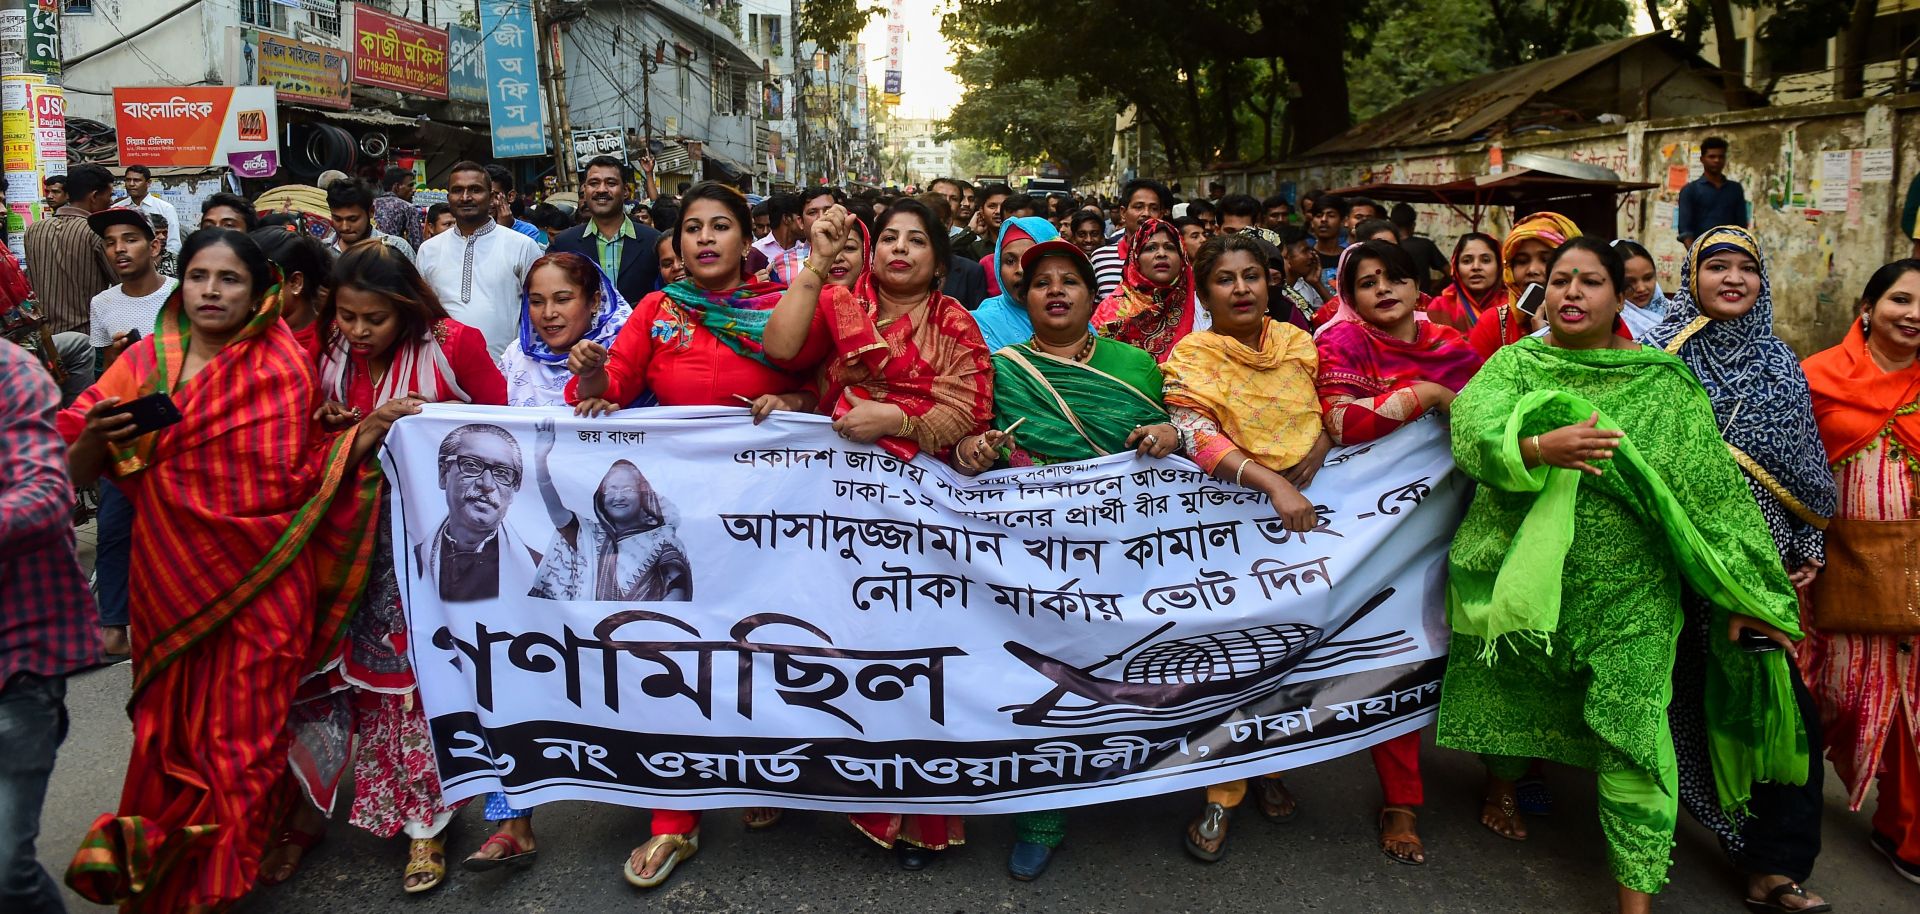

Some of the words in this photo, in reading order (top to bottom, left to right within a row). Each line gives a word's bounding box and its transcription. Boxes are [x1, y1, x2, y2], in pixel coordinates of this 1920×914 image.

[359, 27, 400, 62] কাজী
[401, 38, 445, 72] অফিস
[122, 96, 213, 120] বাংলালিংক
[575, 135, 599, 154] কাজী
[577, 430, 603, 445] জয়
[607, 430, 647, 446] বাংলা
[734, 447, 837, 470] একাদশ
[935, 474, 1008, 506] সংসদ
[833, 479, 939, 514] ঢাকা-১২
[1065, 497, 1127, 528] প্রার্থী
[1133, 492, 1172, 518] বীর
[1177, 486, 1269, 515] মুক্তিযো
[718, 509, 1009, 566] আসাদুজ্জামান
[1023, 533, 1111, 575] খান
[1120, 519, 1242, 570] কামাল
[852, 561, 976, 612] নৌকা
[986, 577, 1124, 623] মার্কায়
[1142, 568, 1238, 615] ভোট
[1247, 556, 1333, 601] দিন
[532, 738, 618, 779] নং
[636, 743, 812, 784] ওয়ার্ড
[1222, 706, 1318, 743] ঢাকা
